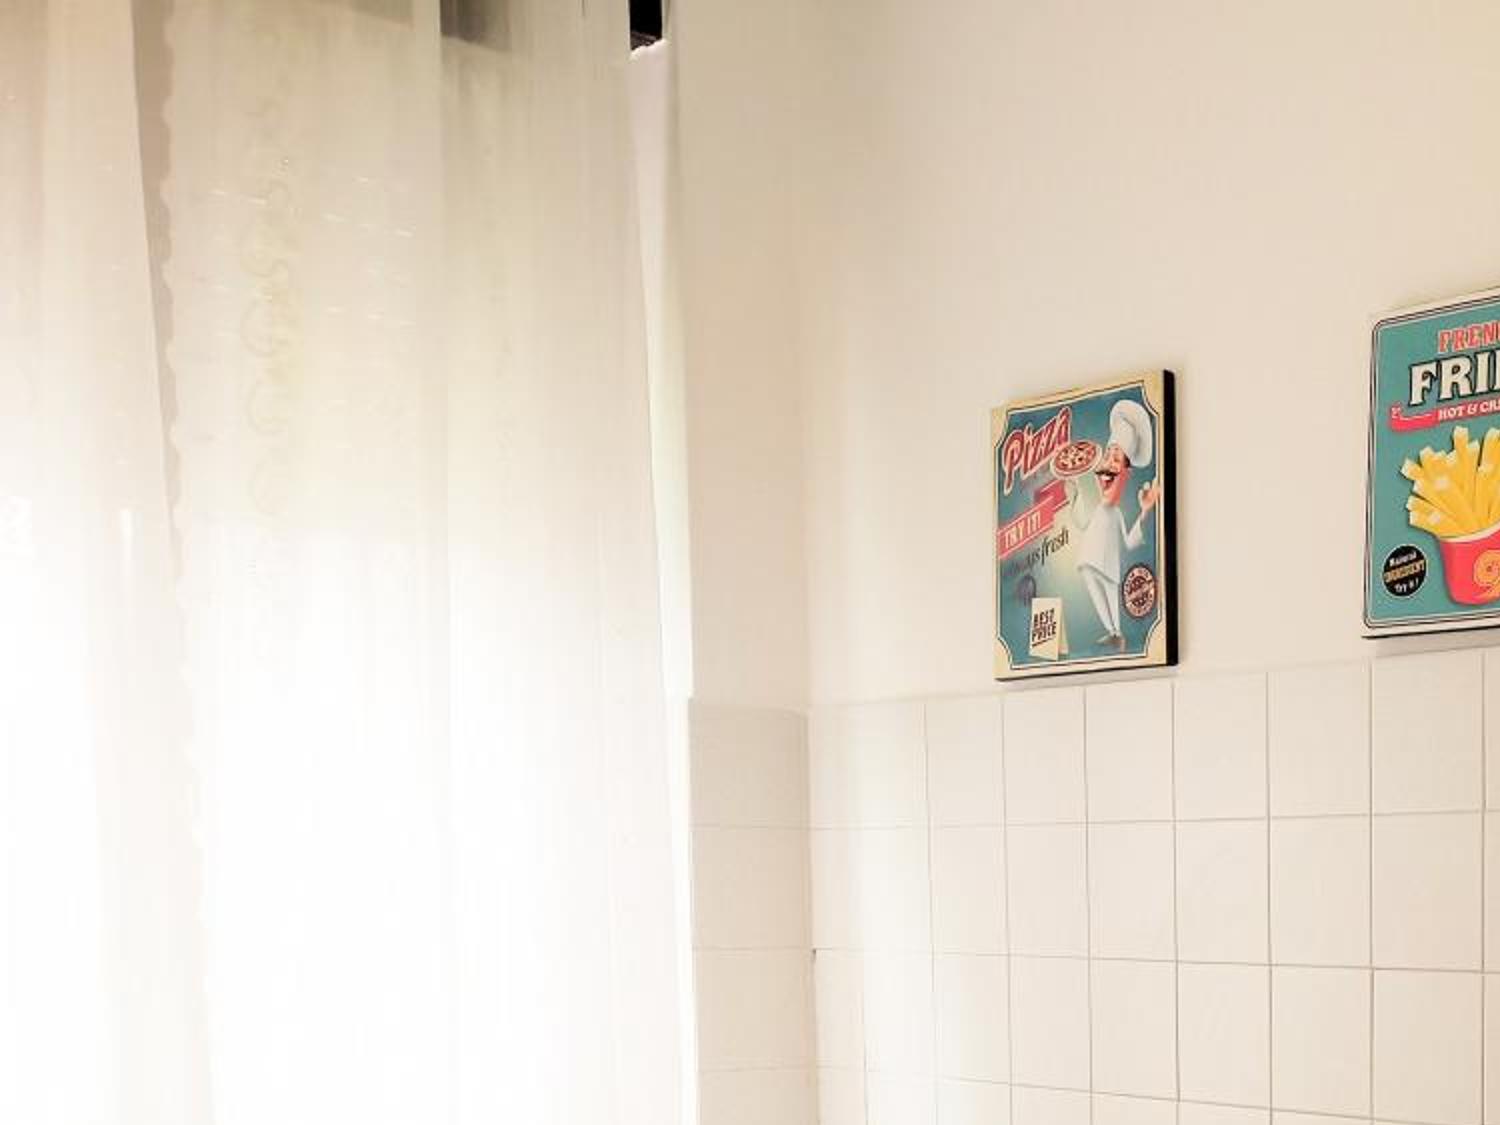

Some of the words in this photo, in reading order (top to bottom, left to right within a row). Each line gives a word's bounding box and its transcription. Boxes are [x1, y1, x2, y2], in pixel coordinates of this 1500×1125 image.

[1437, 405, 1467, 421] HOT
[1467, 402, 1478, 415] &
[1004, 518, 1025, 551] TRY
